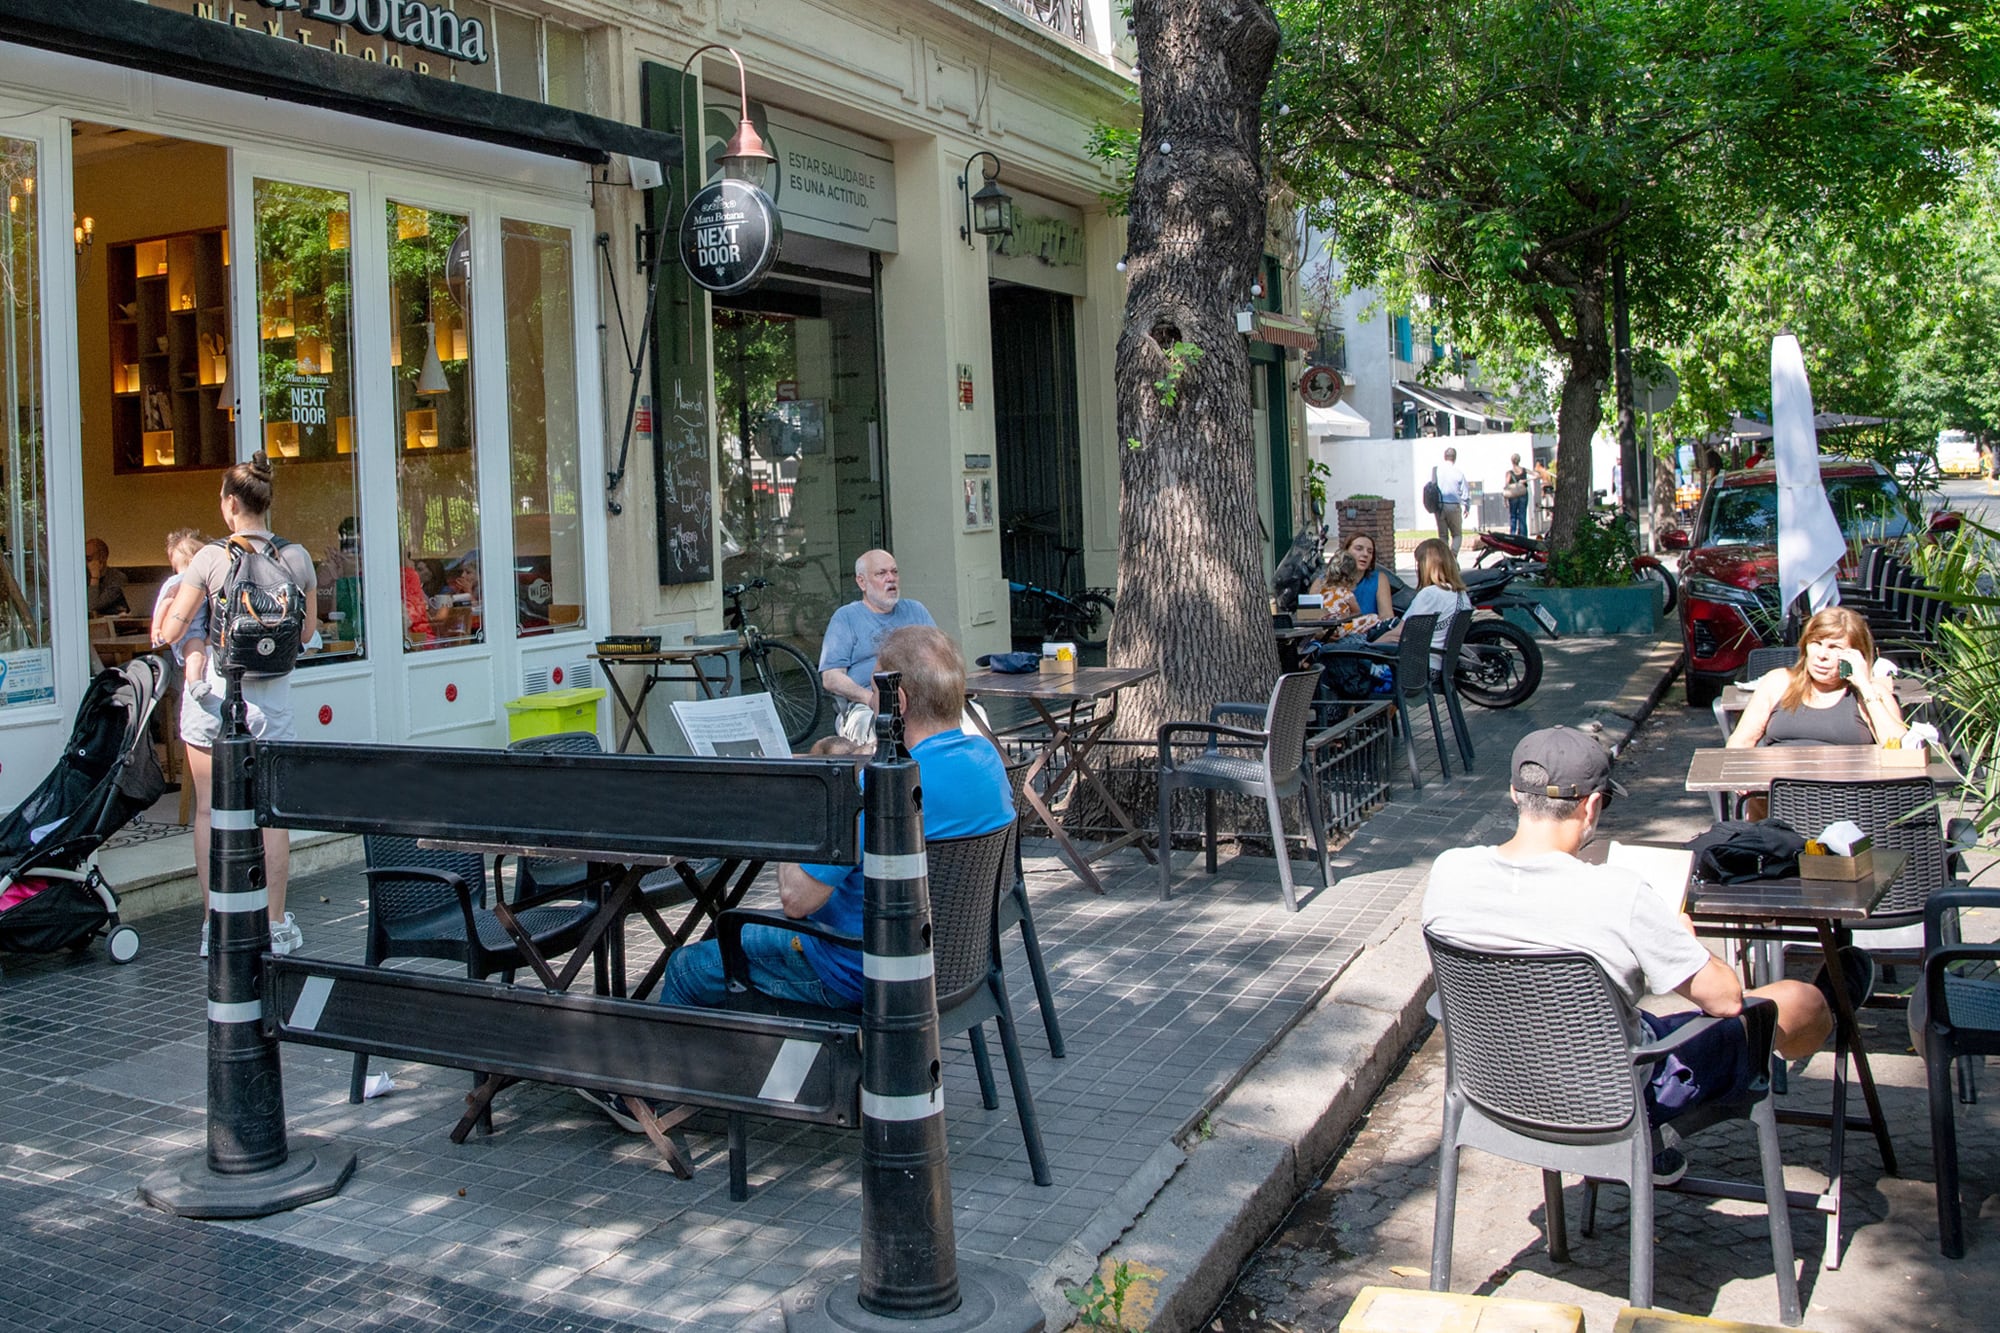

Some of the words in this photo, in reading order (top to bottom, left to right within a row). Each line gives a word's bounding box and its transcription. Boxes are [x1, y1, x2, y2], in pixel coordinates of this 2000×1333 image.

[788, 151, 821, 174] ESTAR
[821, 162, 876, 190] SALUDABLE
[790, 174, 803, 191] ES
[803, 178, 826, 198] UNA
[827, 185, 869, 208] ACTITUD.
[694, 214, 714, 225] Maru
[714, 211, 745, 222] Botana
[697, 224, 740, 248] NEXT
[698, 245, 741, 267] DOOR
[291, 388, 325, 407] NEXT
[292, 407, 326, 425] DOOR
